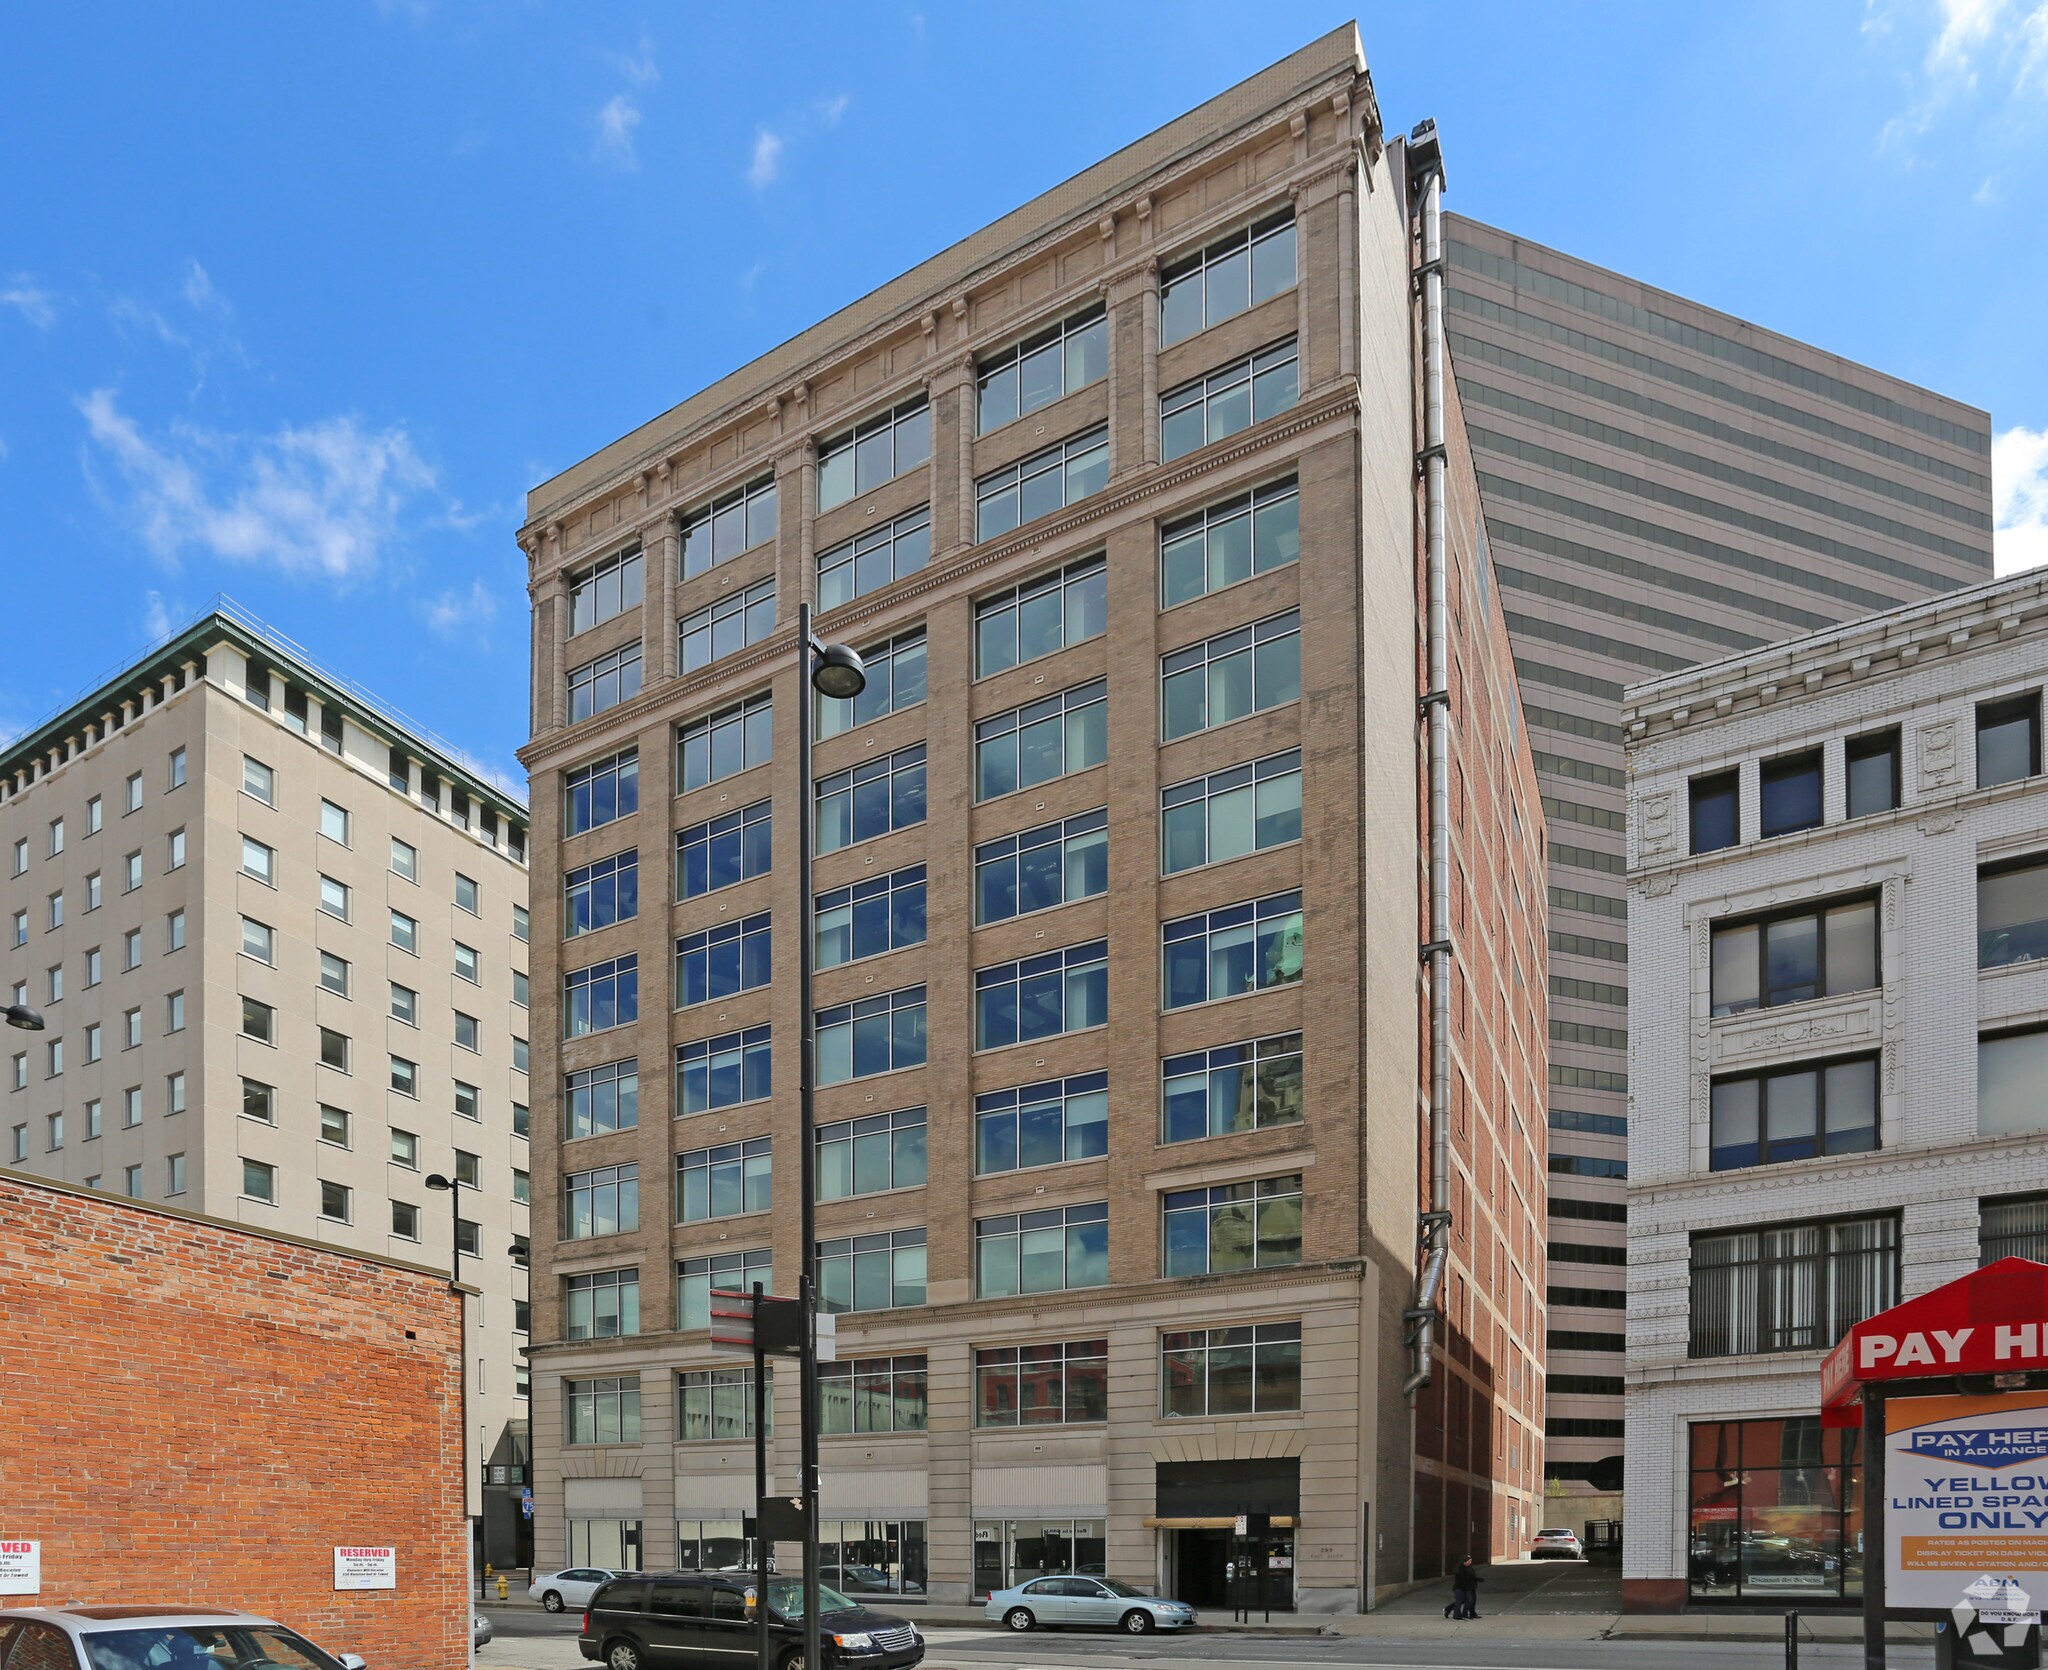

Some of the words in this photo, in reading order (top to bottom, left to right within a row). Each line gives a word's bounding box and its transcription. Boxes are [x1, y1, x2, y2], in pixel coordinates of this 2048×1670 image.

[1860, 1327, 1975, 1369] PAY
[1994, 1322, 2048, 1360] H
[1916, 1433, 1979, 1448] PAY
[1964, 1446, 2047, 1456] ADVANCE
[525, 1502, 534, 1510] 75
[1893, 1496, 1973, 1510] LINED
[1982, 1495, 2048, 1508] SPA
[1938, 1511, 2048, 1529] ONLY
[340, 1548, 390, 1557] RESERVED
[1974, 1578, 2019, 1587] ABM
